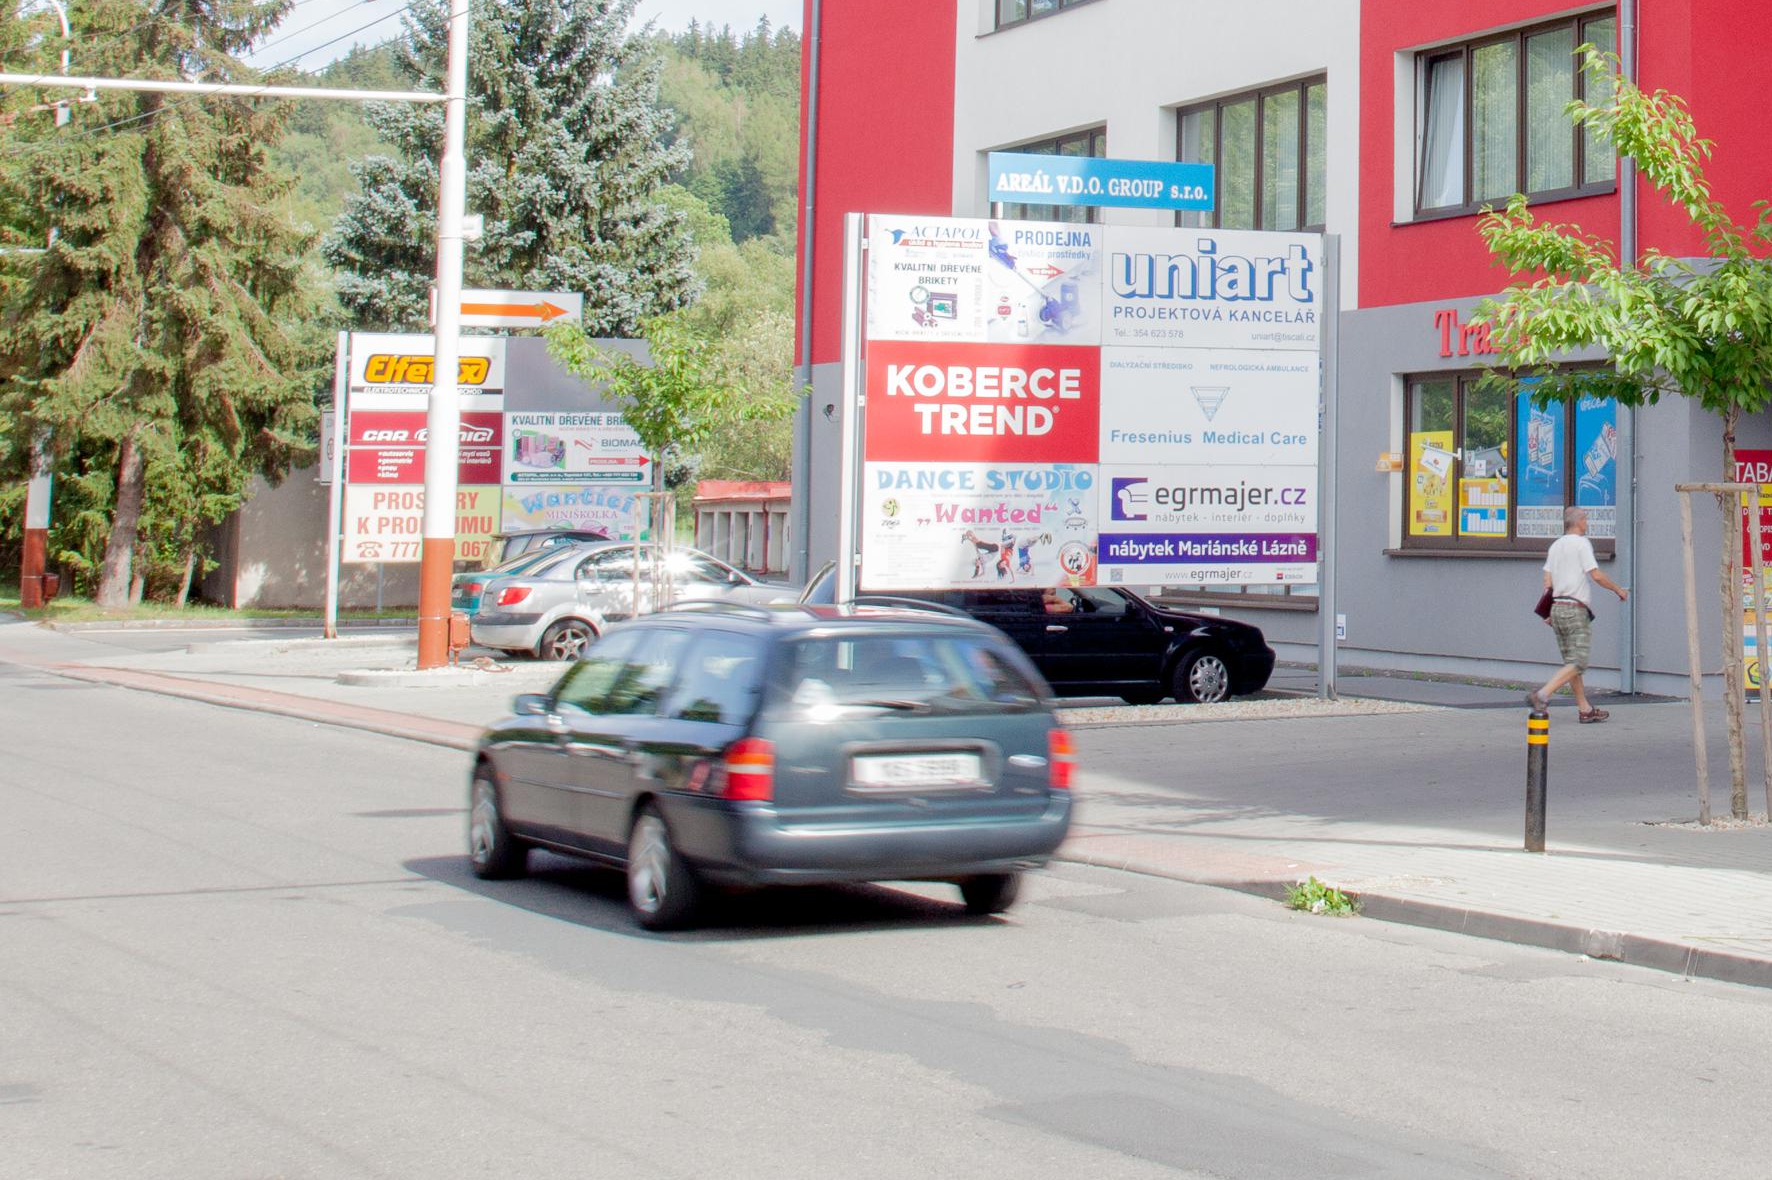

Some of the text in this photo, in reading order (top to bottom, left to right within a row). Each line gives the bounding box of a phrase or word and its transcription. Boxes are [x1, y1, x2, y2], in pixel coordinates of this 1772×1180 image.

[996, 169, 1208, 200] AREÁL V.D.O. GROUP s.r.o.
[911, 226, 980, 240] ACTAPOL
[1015, 230, 1092, 247] PRODEJNA
[1111, 238, 1313, 303] uniart
[918, 276, 958, 285] BRIKETY
[1113, 306, 1315, 323] PROJEKTOVÁ KANCELÁŘ
[1133, 329, 1149, 338] 354
[1151, 330, 1167, 338] 623
[1168, 330, 1184, 338] 578
[1251, 332, 1316, 342] uniart@tiscali.cz
[1266, 365, 1309, 373] AMBULANCE
[887, 364, 1081, 399] KOBERCE
[913, 403, 1054, 436] TREND
[362, 430, 409, 442] CAR
[1111, 430, 1307, 445] Fresenius Medical Care
[877, 470, 1093, 491] DANCE STUDIO
[373, 492, 479, 510] PROSRY
[1155, 481, 1306, 512] egrmajer.cz
[357, 517, 369, 534] K
[1155, 513, 1199, 523] nábytek
[391, 542, 420, 558] 777
[461, 541, 490, 558] 067
[1109, 540, 1307, 561] nábytek Mariánské Lázně
[1165, 567, 1253, 581] www.egrmajer.cz
